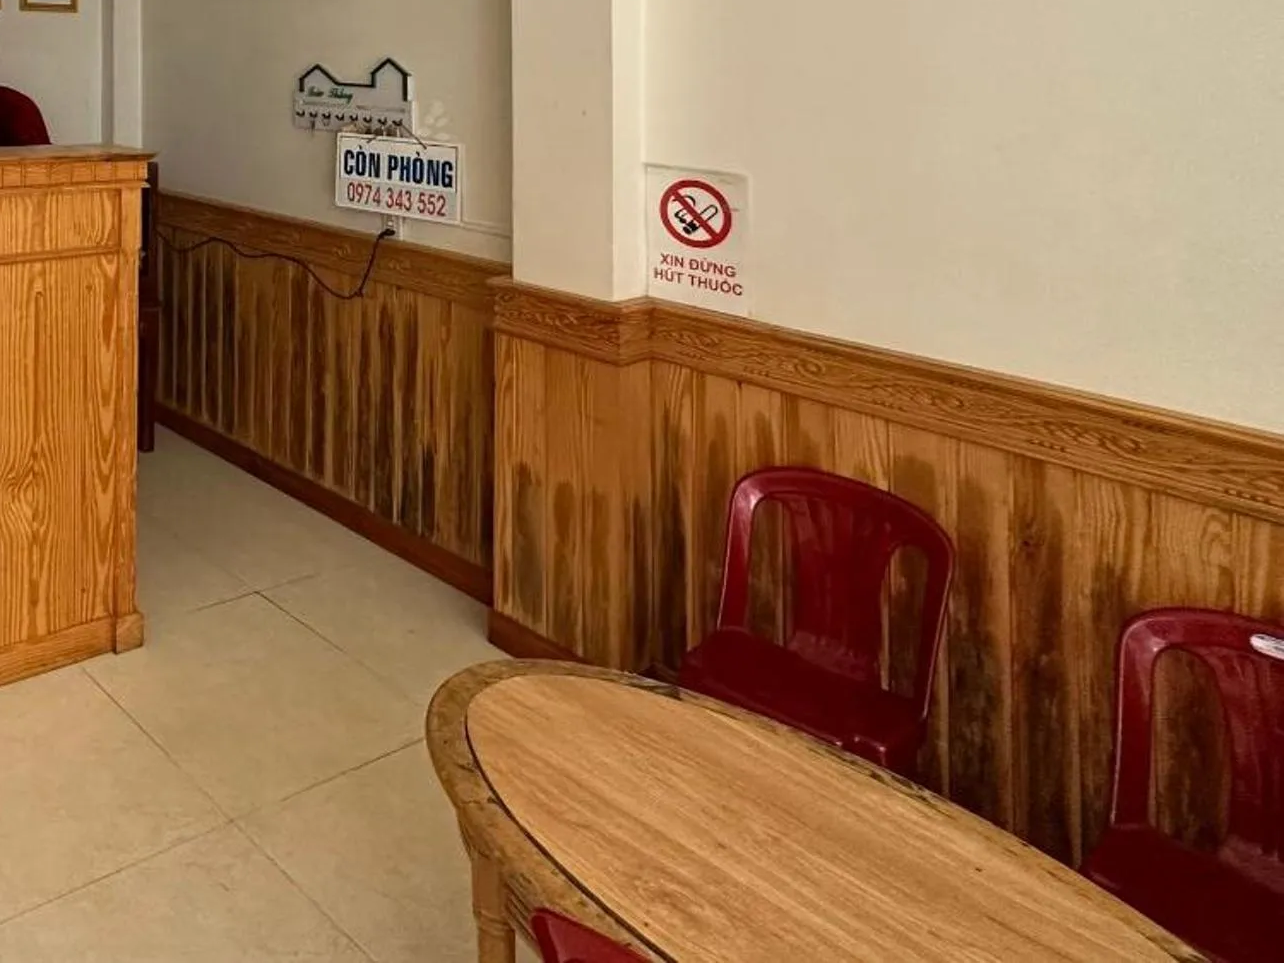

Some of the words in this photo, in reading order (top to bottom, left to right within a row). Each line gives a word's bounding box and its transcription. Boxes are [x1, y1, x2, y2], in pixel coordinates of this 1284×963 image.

[344, 146, 380, 178] CÒN
[387, 152, 453, 188] PHÒNG
[347, 182, 381, 205] 0974
[386, 188, 412, 211] 343
[417, 192, 446, 216] 552
[660, 253, 684, 268] XIN
[654, 266, 684, 283] HÚT
